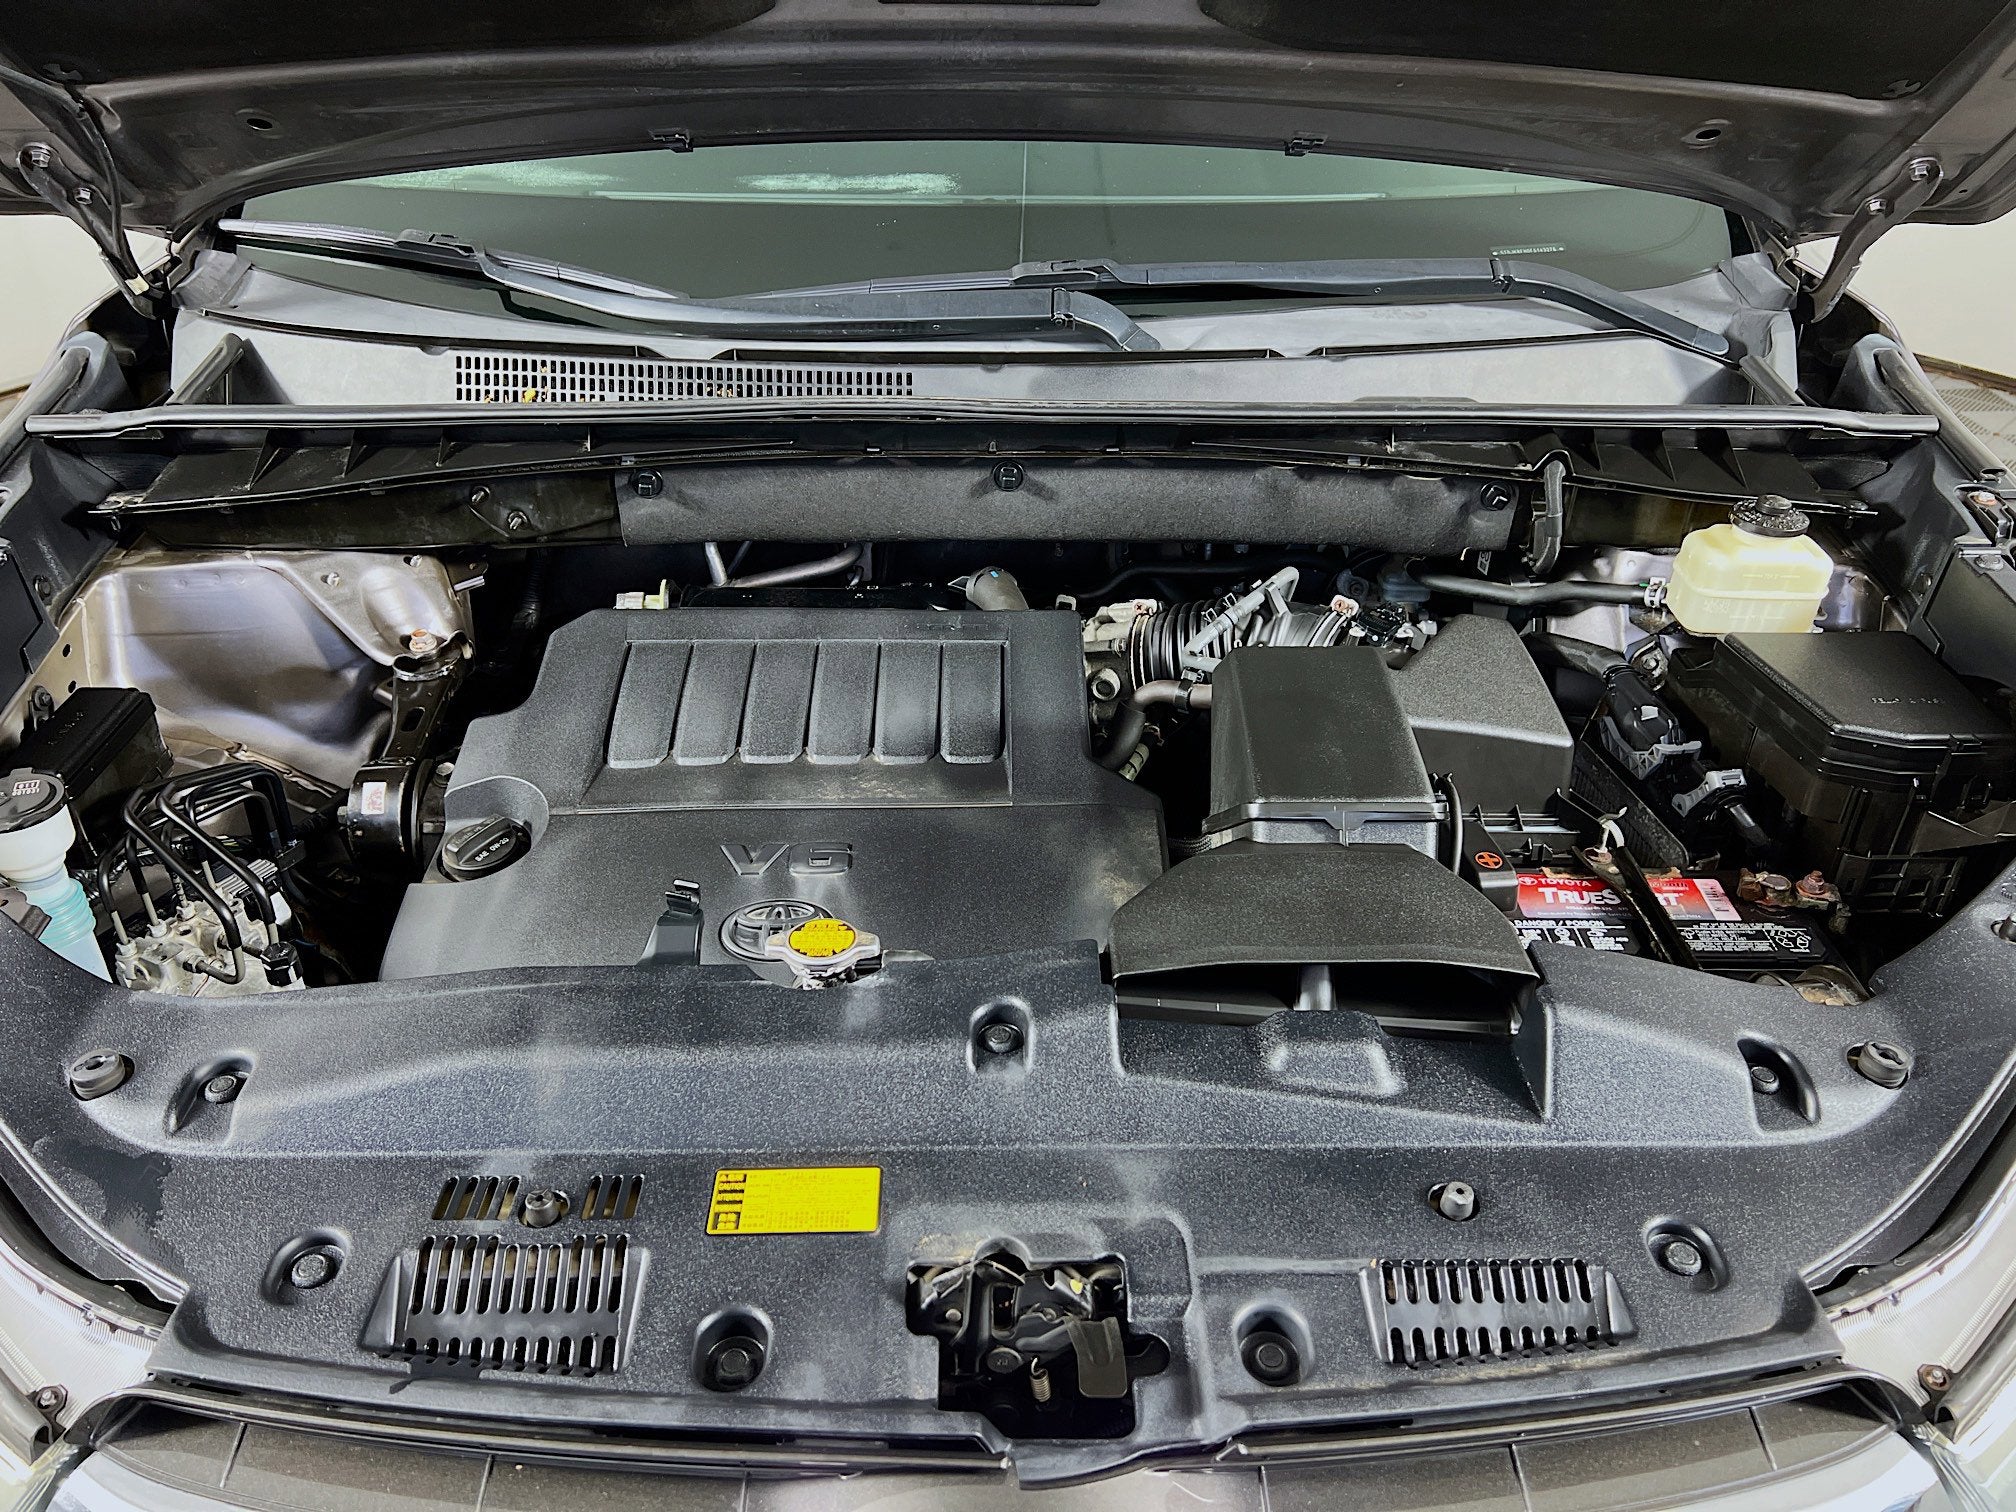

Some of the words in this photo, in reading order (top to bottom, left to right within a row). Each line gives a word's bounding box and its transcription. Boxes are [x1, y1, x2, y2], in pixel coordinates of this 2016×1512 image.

[475, 850, 490, 862] SAE
[489, 837, 509, 851] 0W-20
[720, 842, 853, 876] V6
[1539, 877, 1592, 887] TOYOTA
[1514, 919, 1556, 927] DANGER
